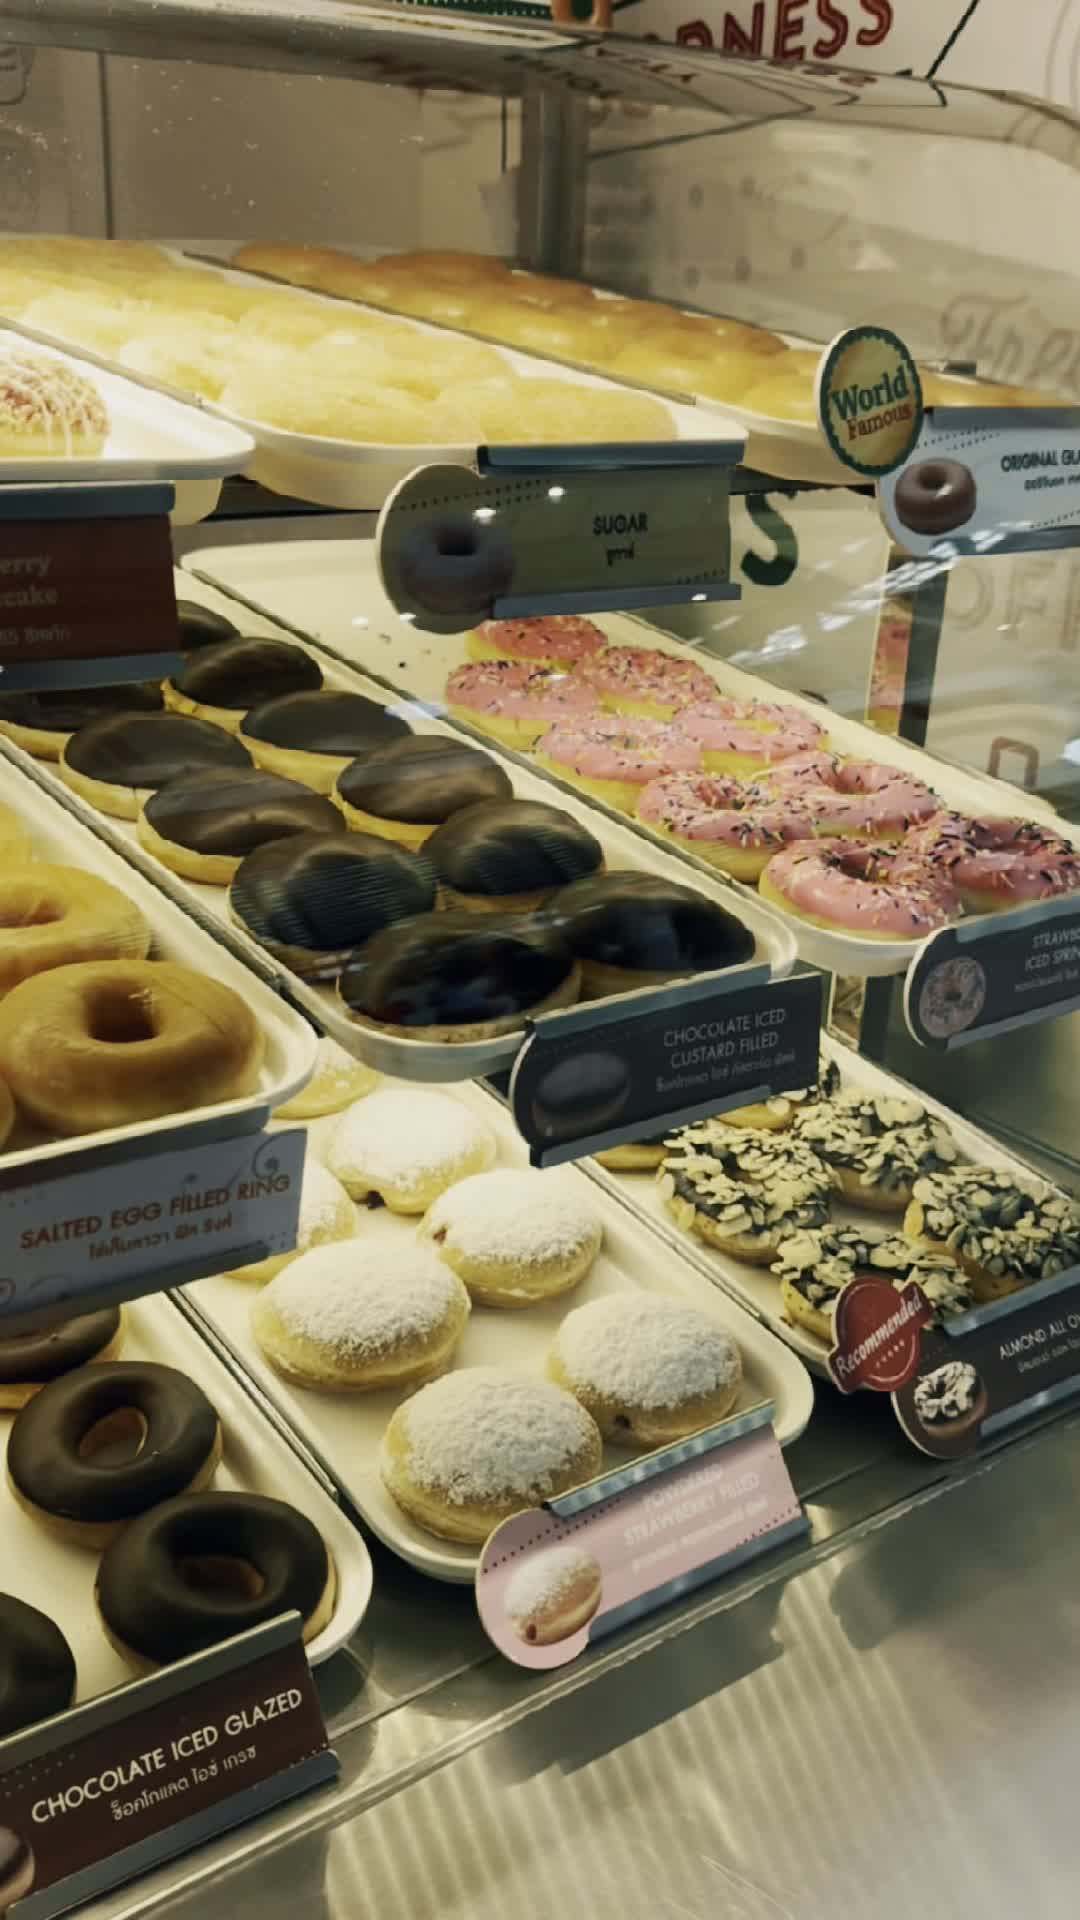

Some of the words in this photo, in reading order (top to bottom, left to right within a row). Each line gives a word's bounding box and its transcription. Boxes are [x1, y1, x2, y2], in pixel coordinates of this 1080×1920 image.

[830, 365, 910, 420] World
[845, 402, 914, 441] Famous
[1000, 451, 1058, 473] ORIGINAL
[1062, 448, 1080, 466] GL
[592, 512, 649, 536] SUGAR
[663, 1014, 752, 1048] CHOCOLATE
[755, 1007, 787, 1029] ICED
[670, 1039, 735, 1069] CUSTARD
[739, 1030, 779, 1057] FILLED
[20, 1214, 103, 1250] SALTED
[110, 1201, 162, 1230] EGG
[169, 1187, 231, 1218] FILLED
[236, 1173, 291, 1201] RING
[835, 1292, 923, 1378] Recommended
[1000, 1327, 1048, 1361] ALMOND
[1049, 1319, 1069, 1339] ALL
[31, 1748, 167, 1823] CHOCOLATE
[171, 1724, 220, 1761] ICED
[224, 1688, 303, 1737] GLAZED
